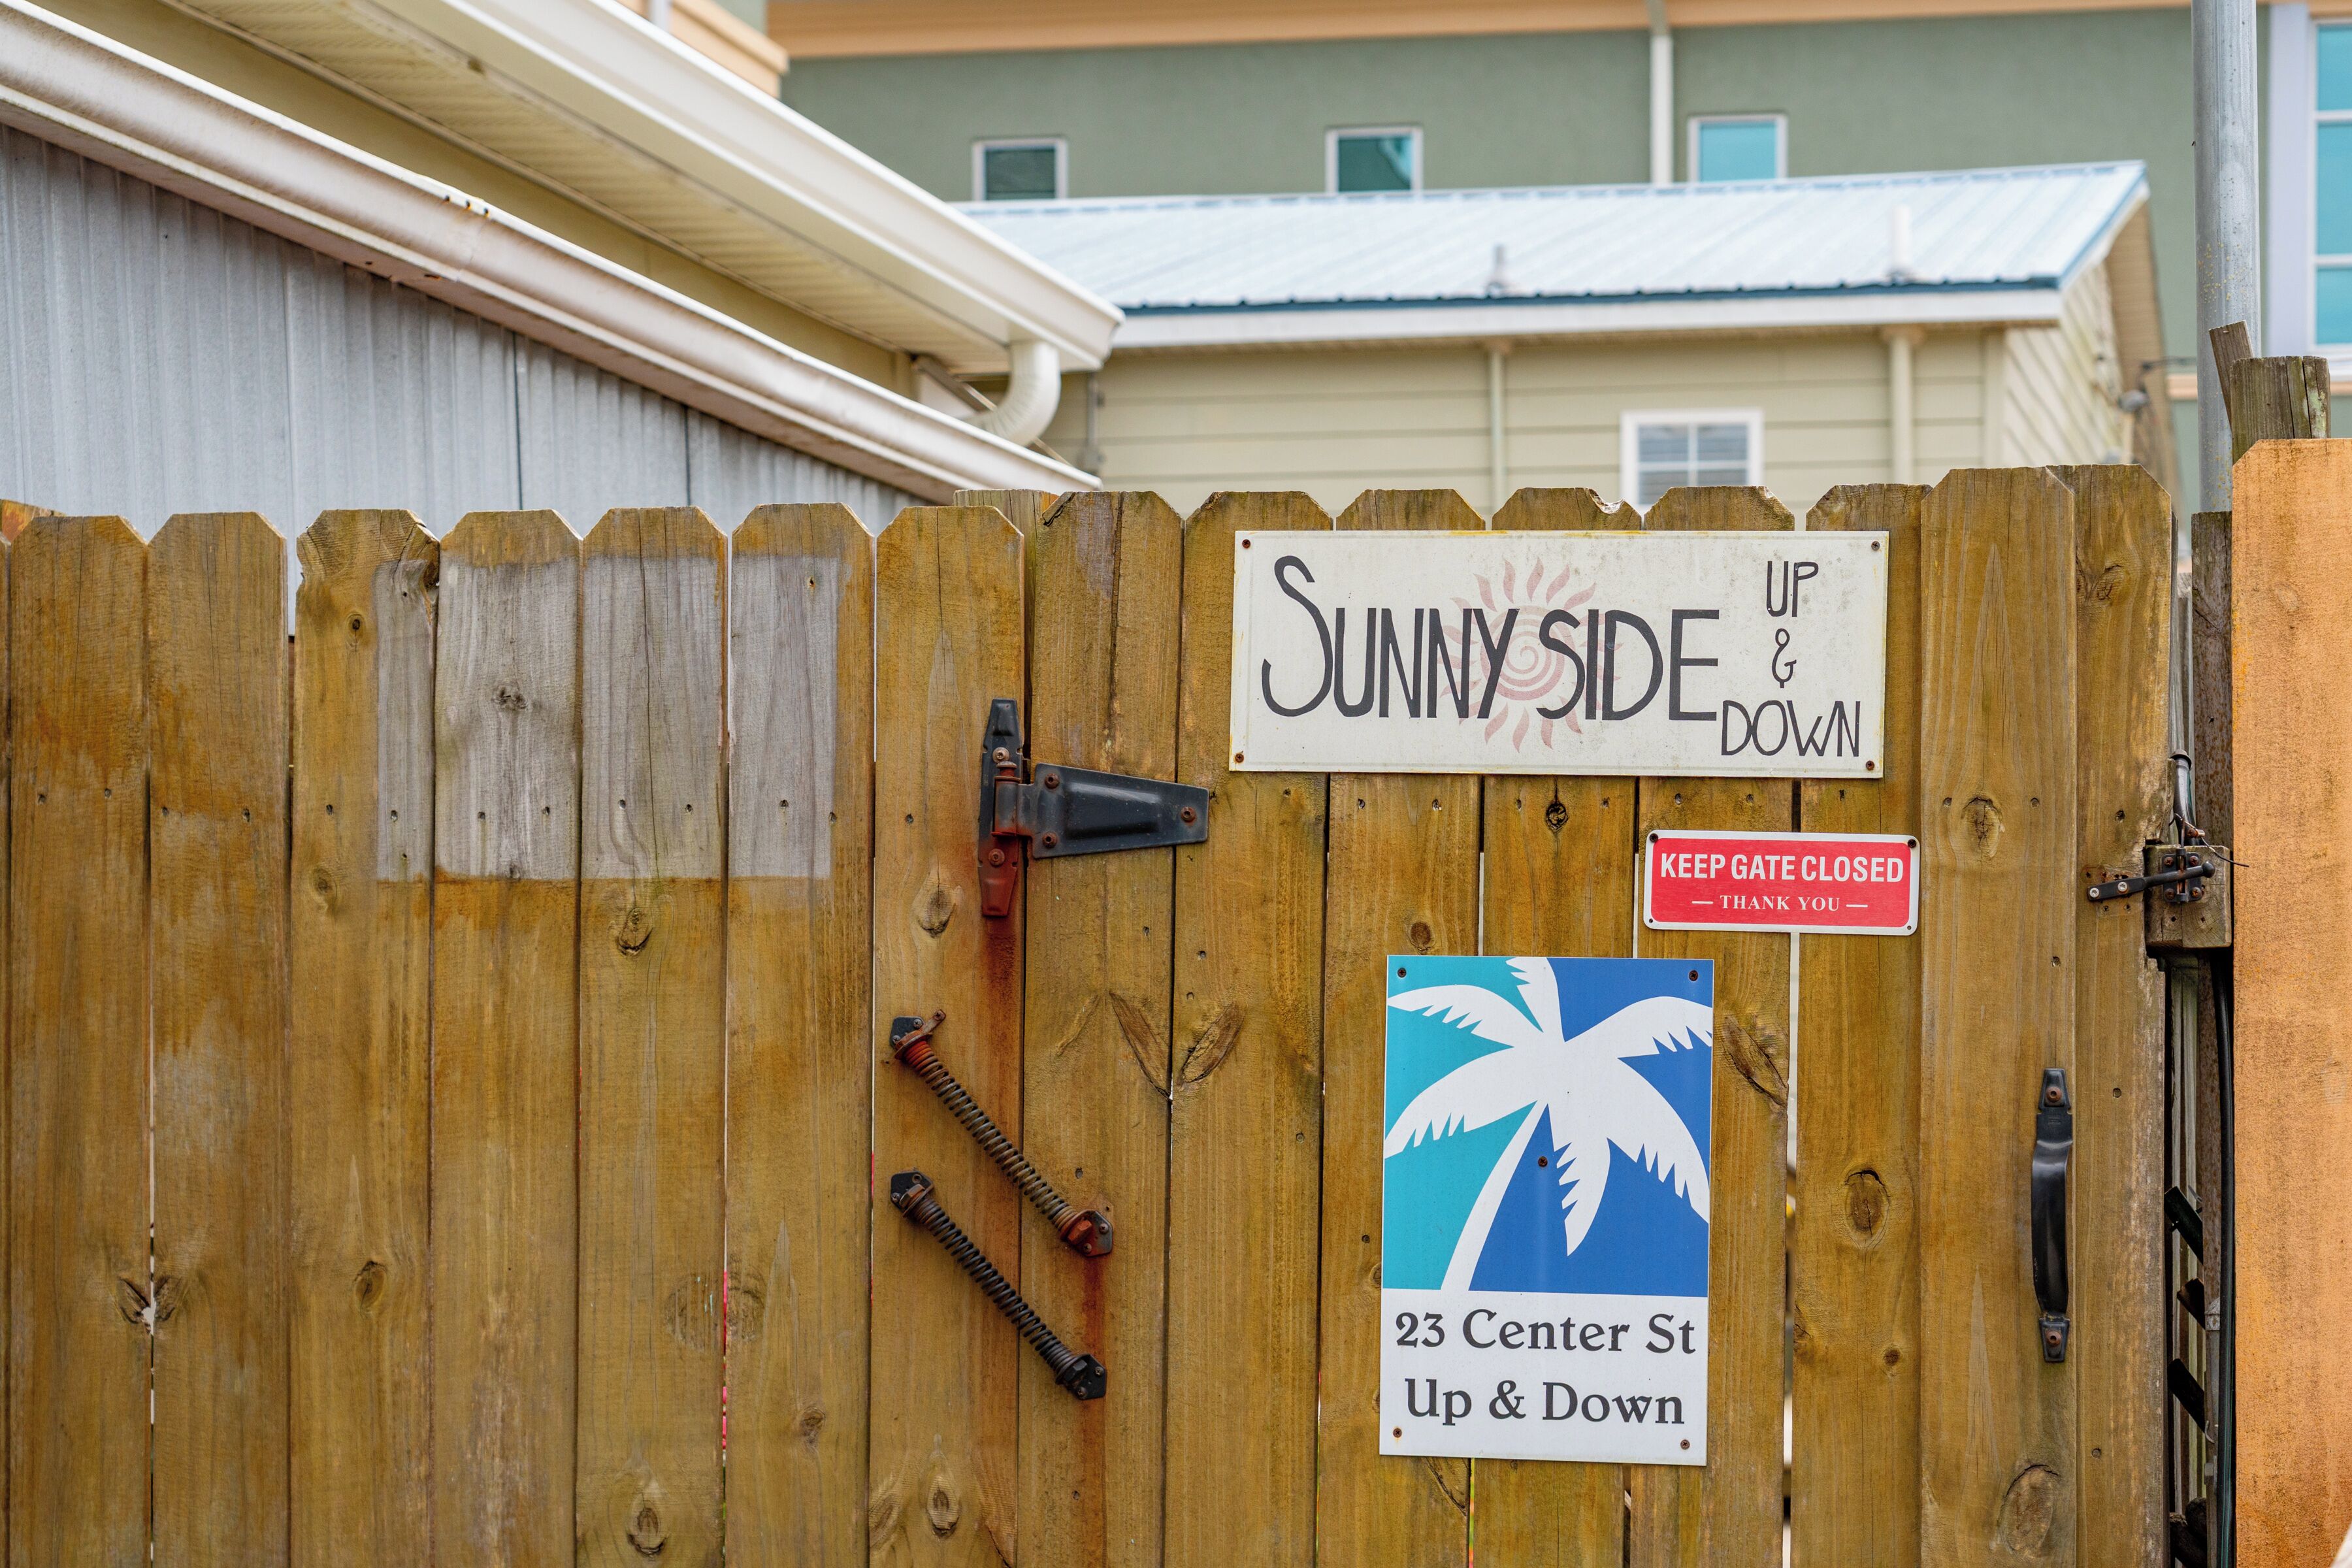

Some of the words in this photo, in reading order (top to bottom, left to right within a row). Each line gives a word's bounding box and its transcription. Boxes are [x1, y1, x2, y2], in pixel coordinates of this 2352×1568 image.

[1766, 561, 1819, 617] UP
[1262, 555, 1520, 719] SUNNY
[1536, 609, 1720, 721] SIDE
[1771, 628, 1797, 689] &
[1721, 700, 1861, 757] DOWN
[1661, 853, 1725, 879] KEEP
[1731, 854, 1796, 881] GATE
[1801, 855, 1904, 883] CLOSED
[1719, 894, 1791, 910] THANK
[1798, 896, 1840, 911] YOU
[1396, 1312, 1445, 1348] 23
[1462, 1309, 1631, 1352] Center
[1645, 1313, 1697, 1354] St
[1405, 1378, 1472, 1426] Up
[1489, 1380, 1527, 1420] &
[1542, 1382, 1685, 1424] Down
